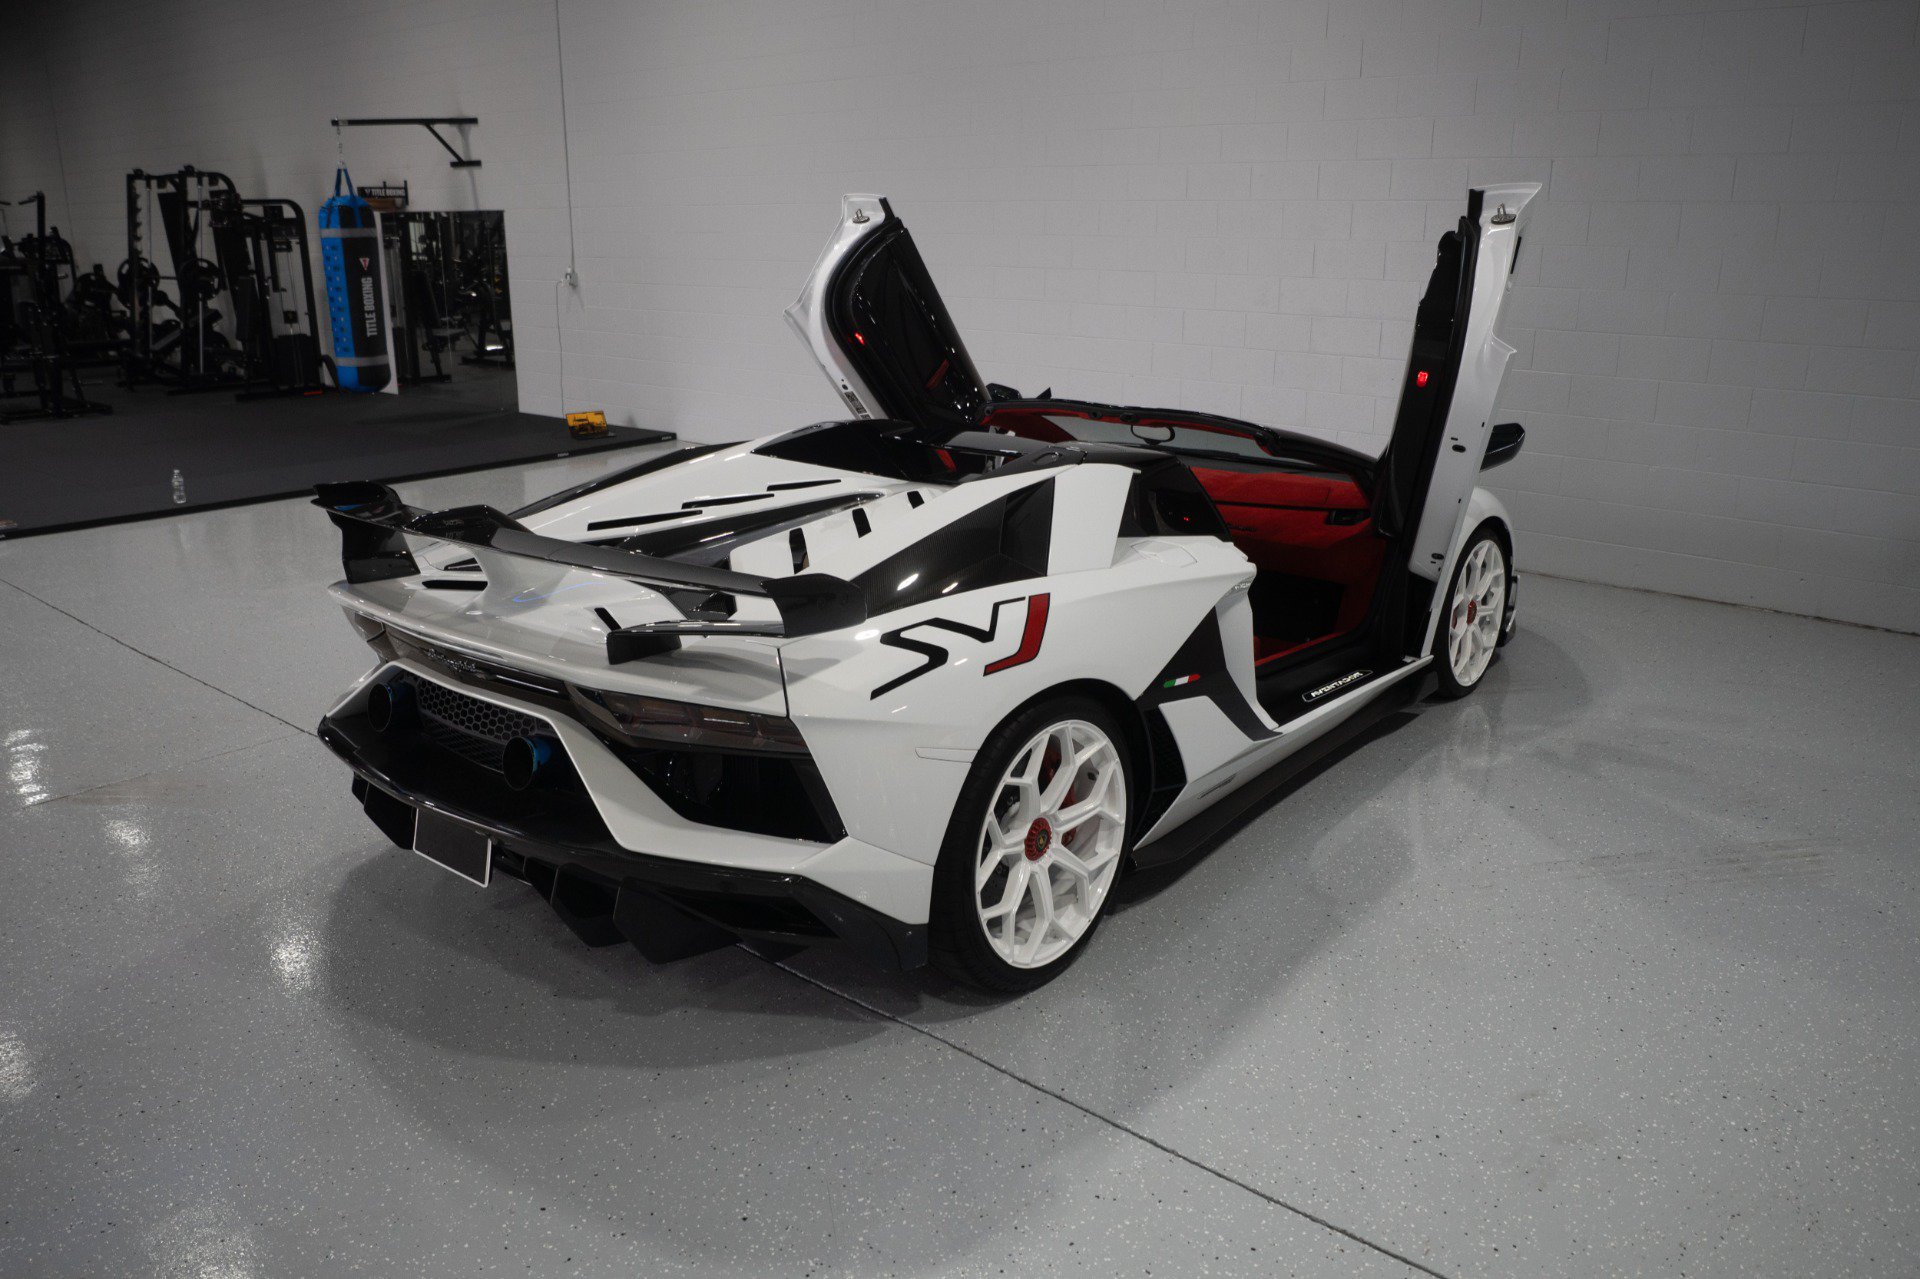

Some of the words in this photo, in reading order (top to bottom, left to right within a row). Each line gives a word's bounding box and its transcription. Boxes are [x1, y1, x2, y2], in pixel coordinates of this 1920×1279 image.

[371, 188, 386, 197] TITLE
[386, 188, 406, 197] BOXING
[361, 277, 375, 311] BOXING
[365, 312, 378, 337] TITLE
[870, 592, 1051, 701] SVJ
